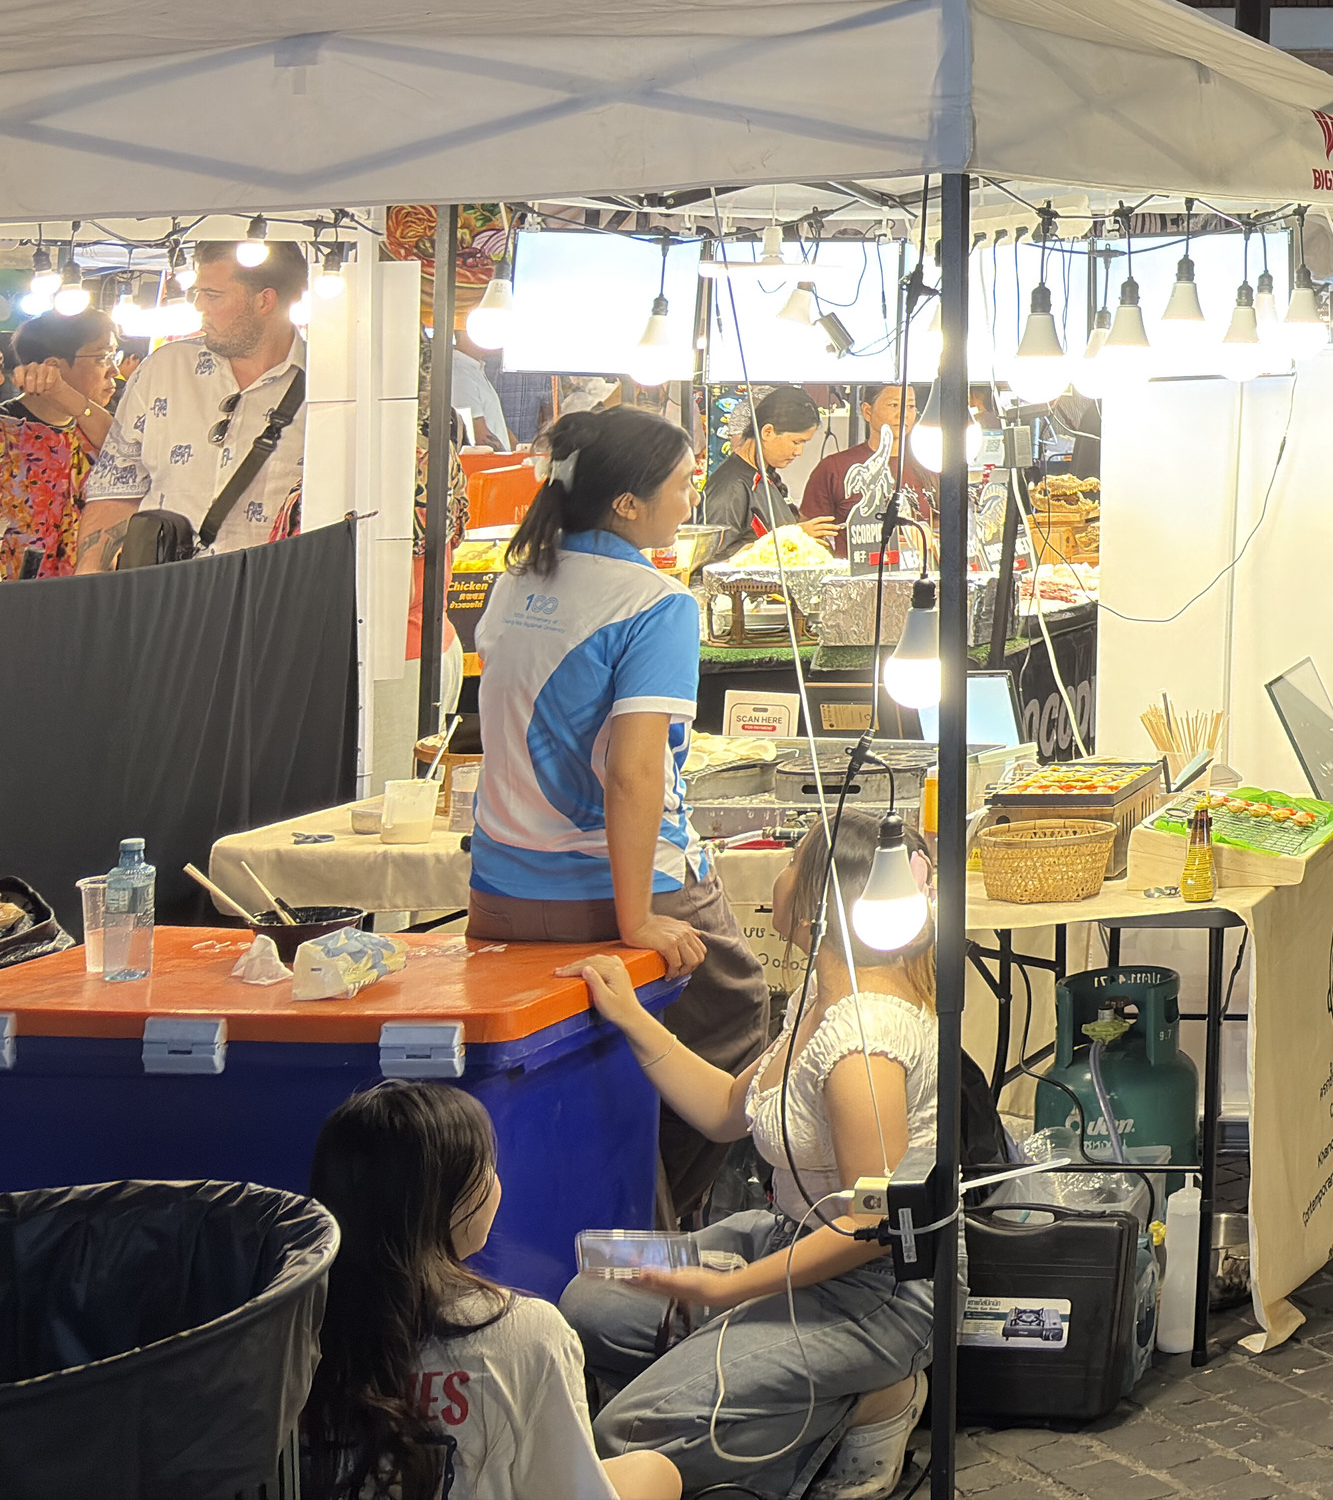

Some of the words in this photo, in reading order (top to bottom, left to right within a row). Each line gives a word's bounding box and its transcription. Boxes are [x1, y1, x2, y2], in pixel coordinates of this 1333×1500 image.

[851, 523, 883, 545] SCORPI
[447, 581, 489, 591] Chicken
[525, 593, 559, 614] 100
[736, 715, 760, 723] SCAN
[761, 716, 783, 725] HERE
[409, 1371, 470, 1426] ES
